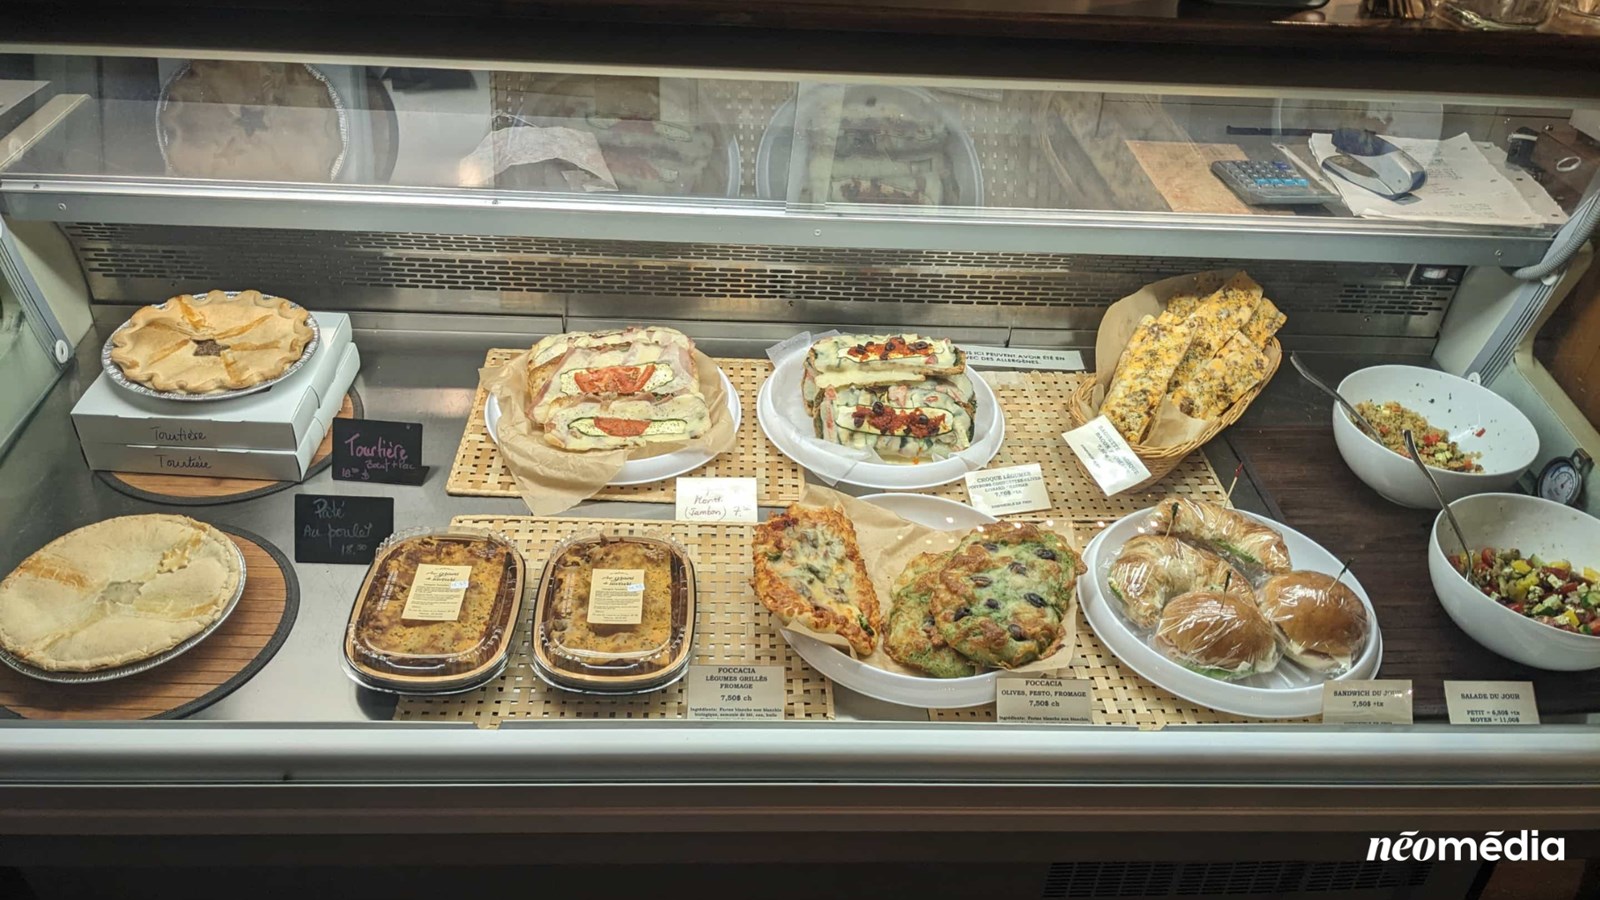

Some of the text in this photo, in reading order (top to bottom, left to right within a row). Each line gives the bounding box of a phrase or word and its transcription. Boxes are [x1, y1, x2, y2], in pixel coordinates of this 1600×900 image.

[344, 432, 408, 460] Tourtière
[303, 522, 373, 549] Au poulet
[720, 694, 741, 702] 7,50$
[1029, 700, 1050, 708] 7,50$
